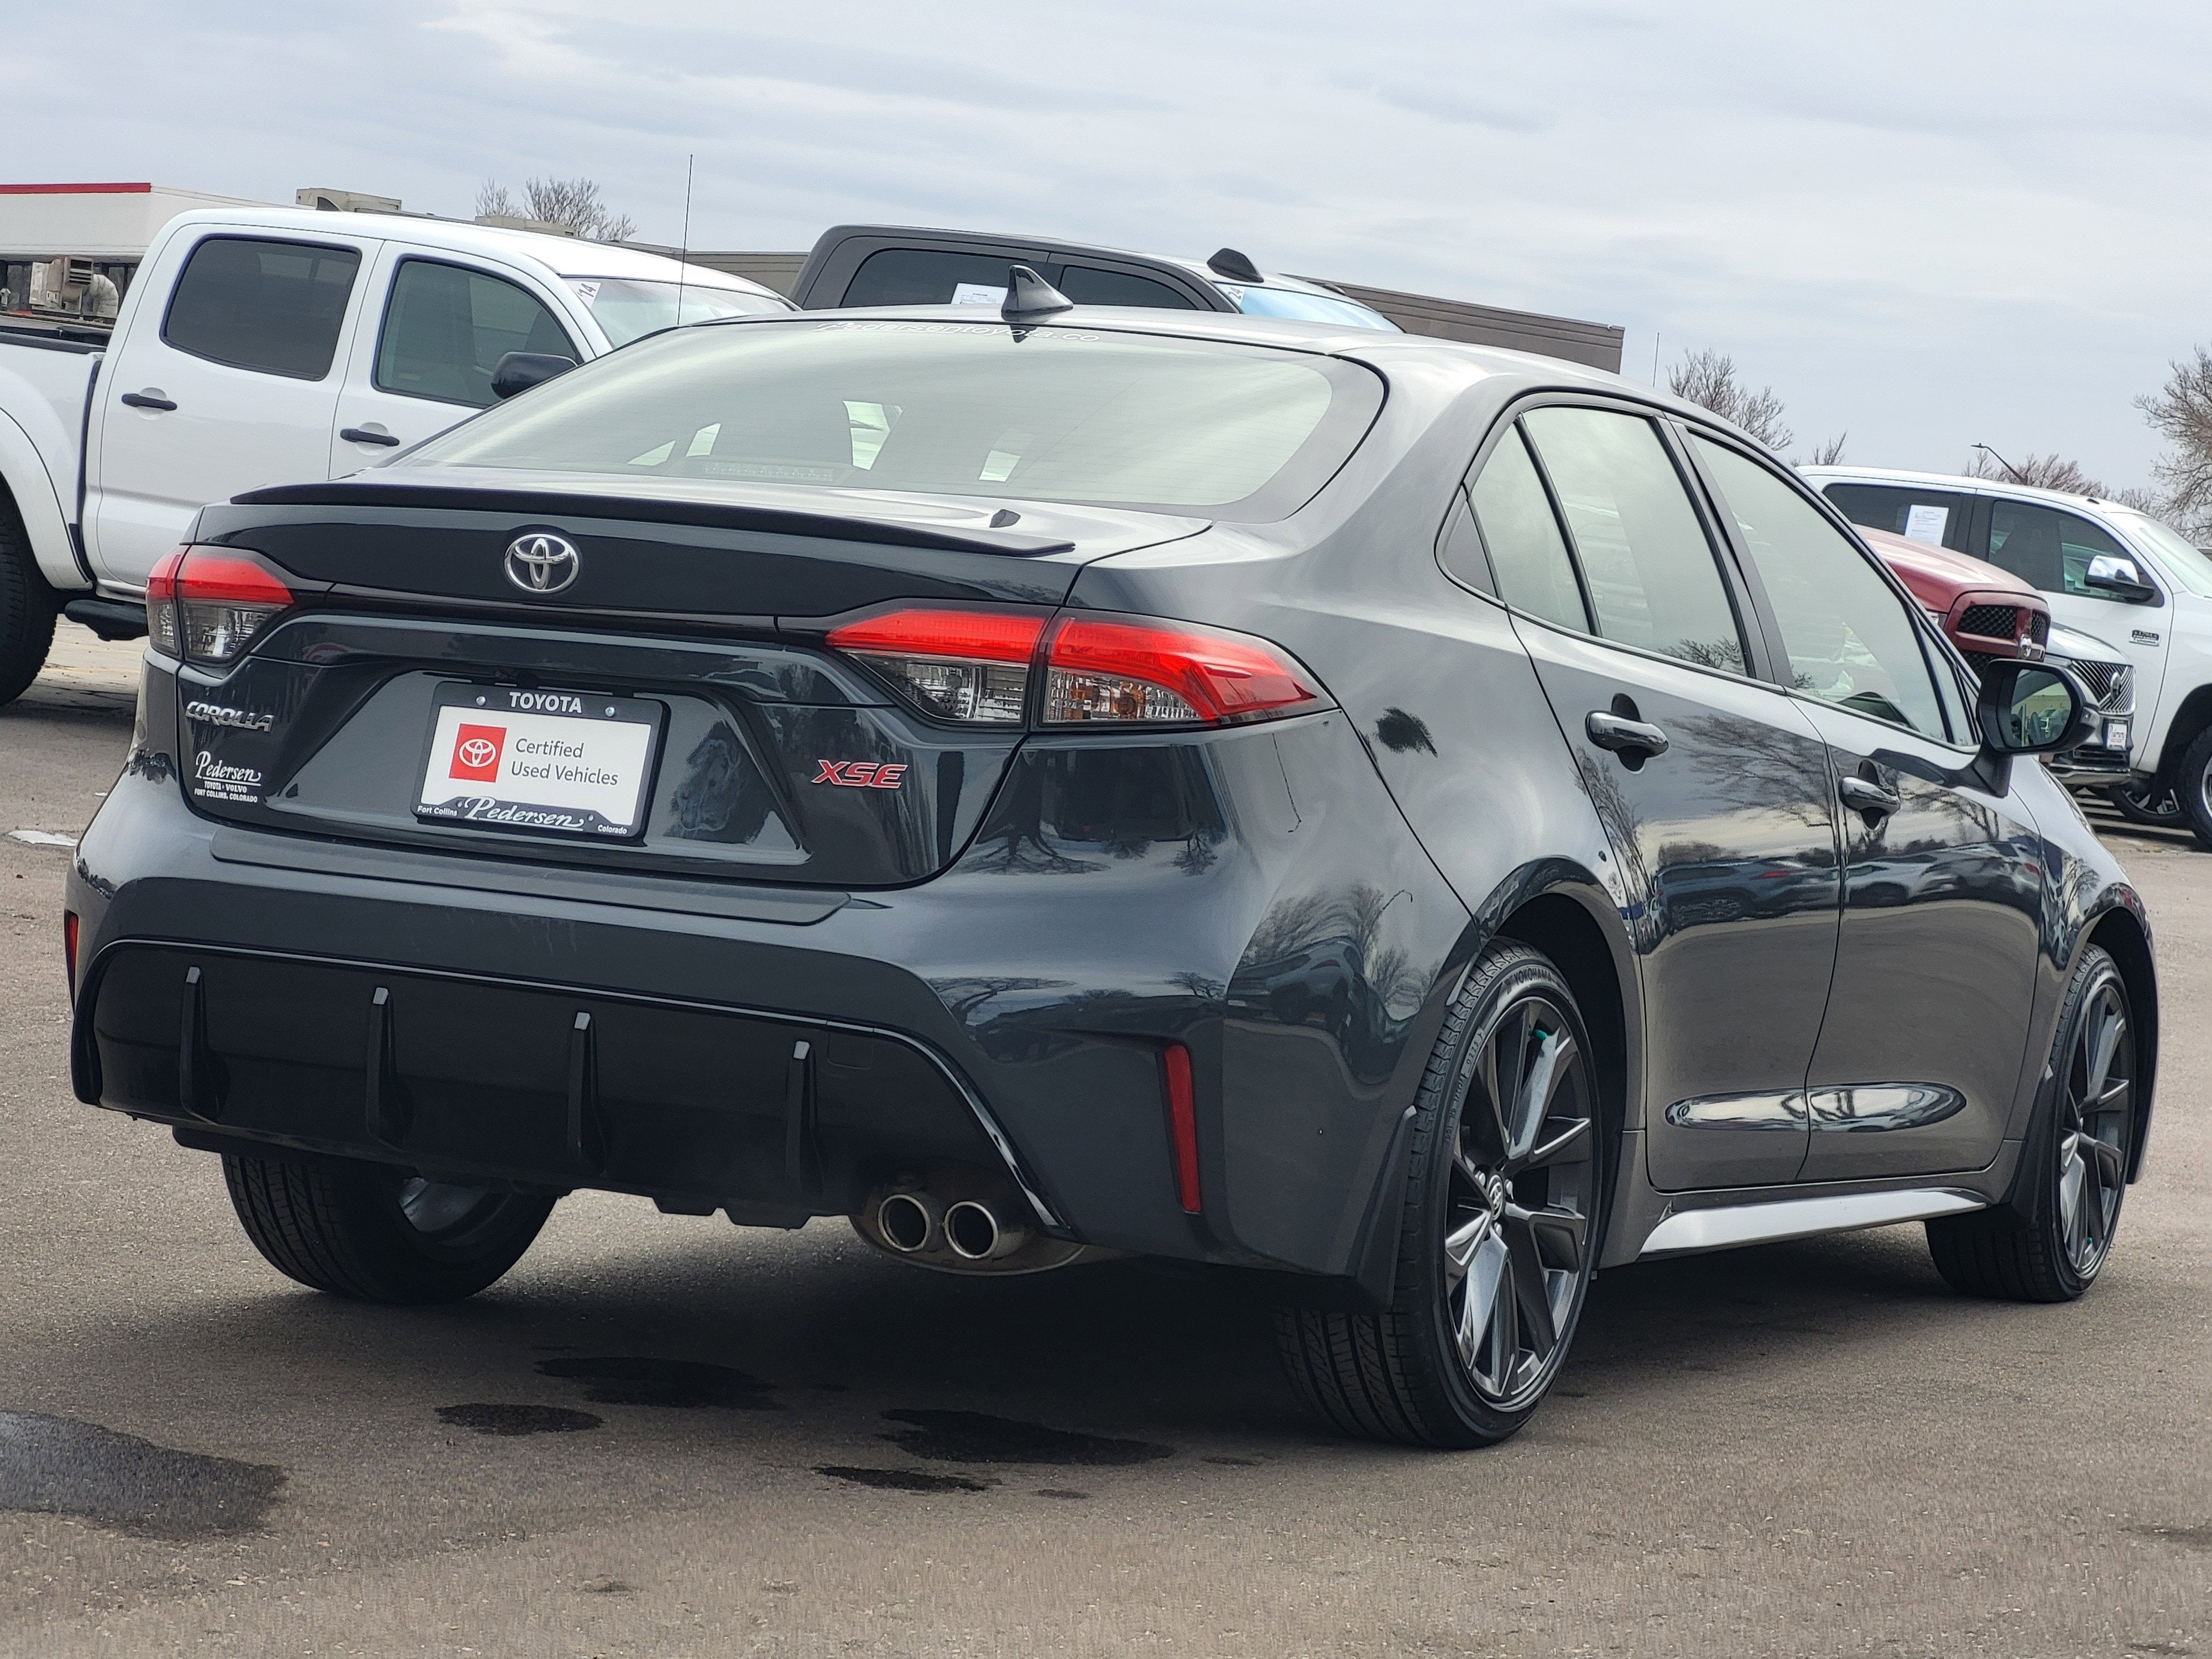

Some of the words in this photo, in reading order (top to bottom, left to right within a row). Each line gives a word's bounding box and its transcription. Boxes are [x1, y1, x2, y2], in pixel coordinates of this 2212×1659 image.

[509, 691, 582, 713] TOYOTA
[185, 701, 274, 732] COROLLA
[515, 738, 585, 758] Certified
[195, 751, 261, 782] Pedersen
[511, 761, 551, 780] Used
[555, 765, 618, 786] Vehicles
[811, 759, 909, 789] XSE
[194, 788, 206, 796] FORT
[229, 794, 258, 803] COLORADO
[204, 781, 221, 790] TOYOTA
[226, 784, 247, 793] VOLVO
[418, 805, 432, 815] Fort
[434, 807, 457, 817] Collins
[464, 796, 585, 828] Pedersen
[597, 824, 628, 835] Colorado
[1514, 967, 1552, 985] YOKOHAMA
